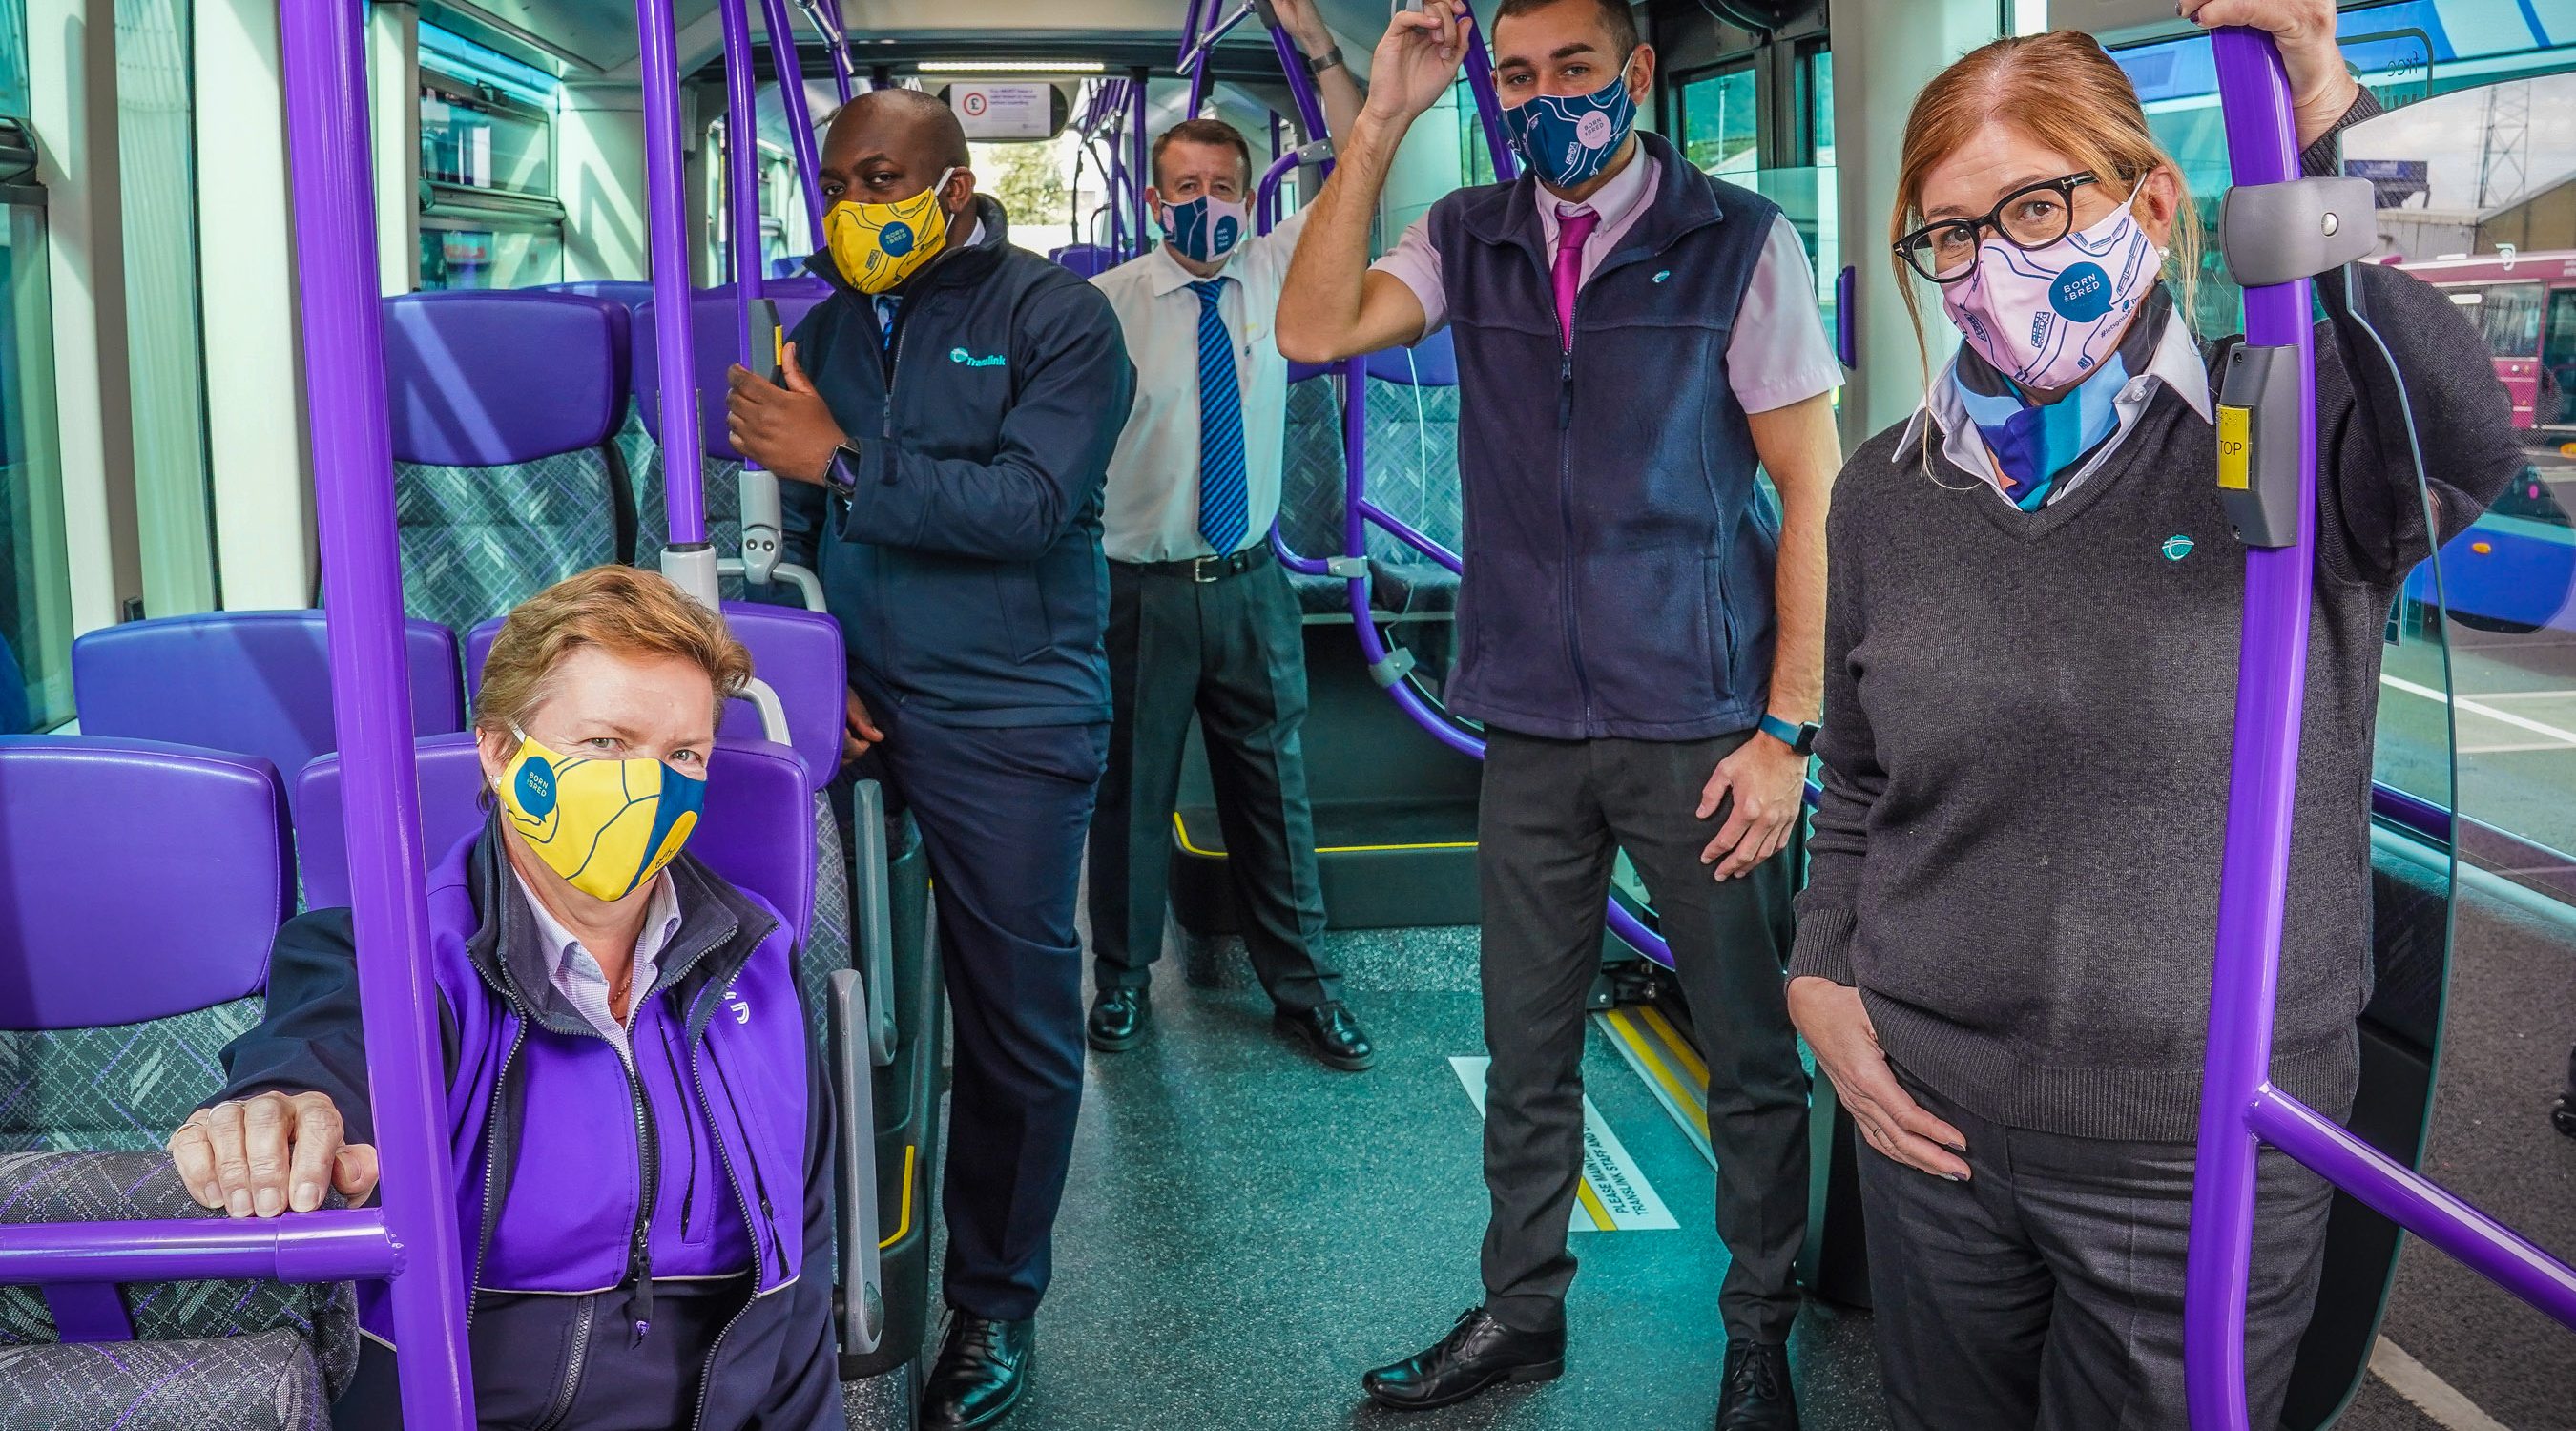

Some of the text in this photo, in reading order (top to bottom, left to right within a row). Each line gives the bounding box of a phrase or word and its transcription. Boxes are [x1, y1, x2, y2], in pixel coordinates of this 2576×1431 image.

[1584, 117, 1602, 131] BORN
[885, 228, 904, 239] BORN
[2064, 273, 2096, 293] BORN
[2220, 441, 2242, 456] TOP
[529, 771, 549, 789] BORN
[1593, 1149, 1618, 1172] STAFF
[1598, 1184, 1628, 1214] PLEASE
[1611, 1172, 1649, 1216] TRANSLINK
